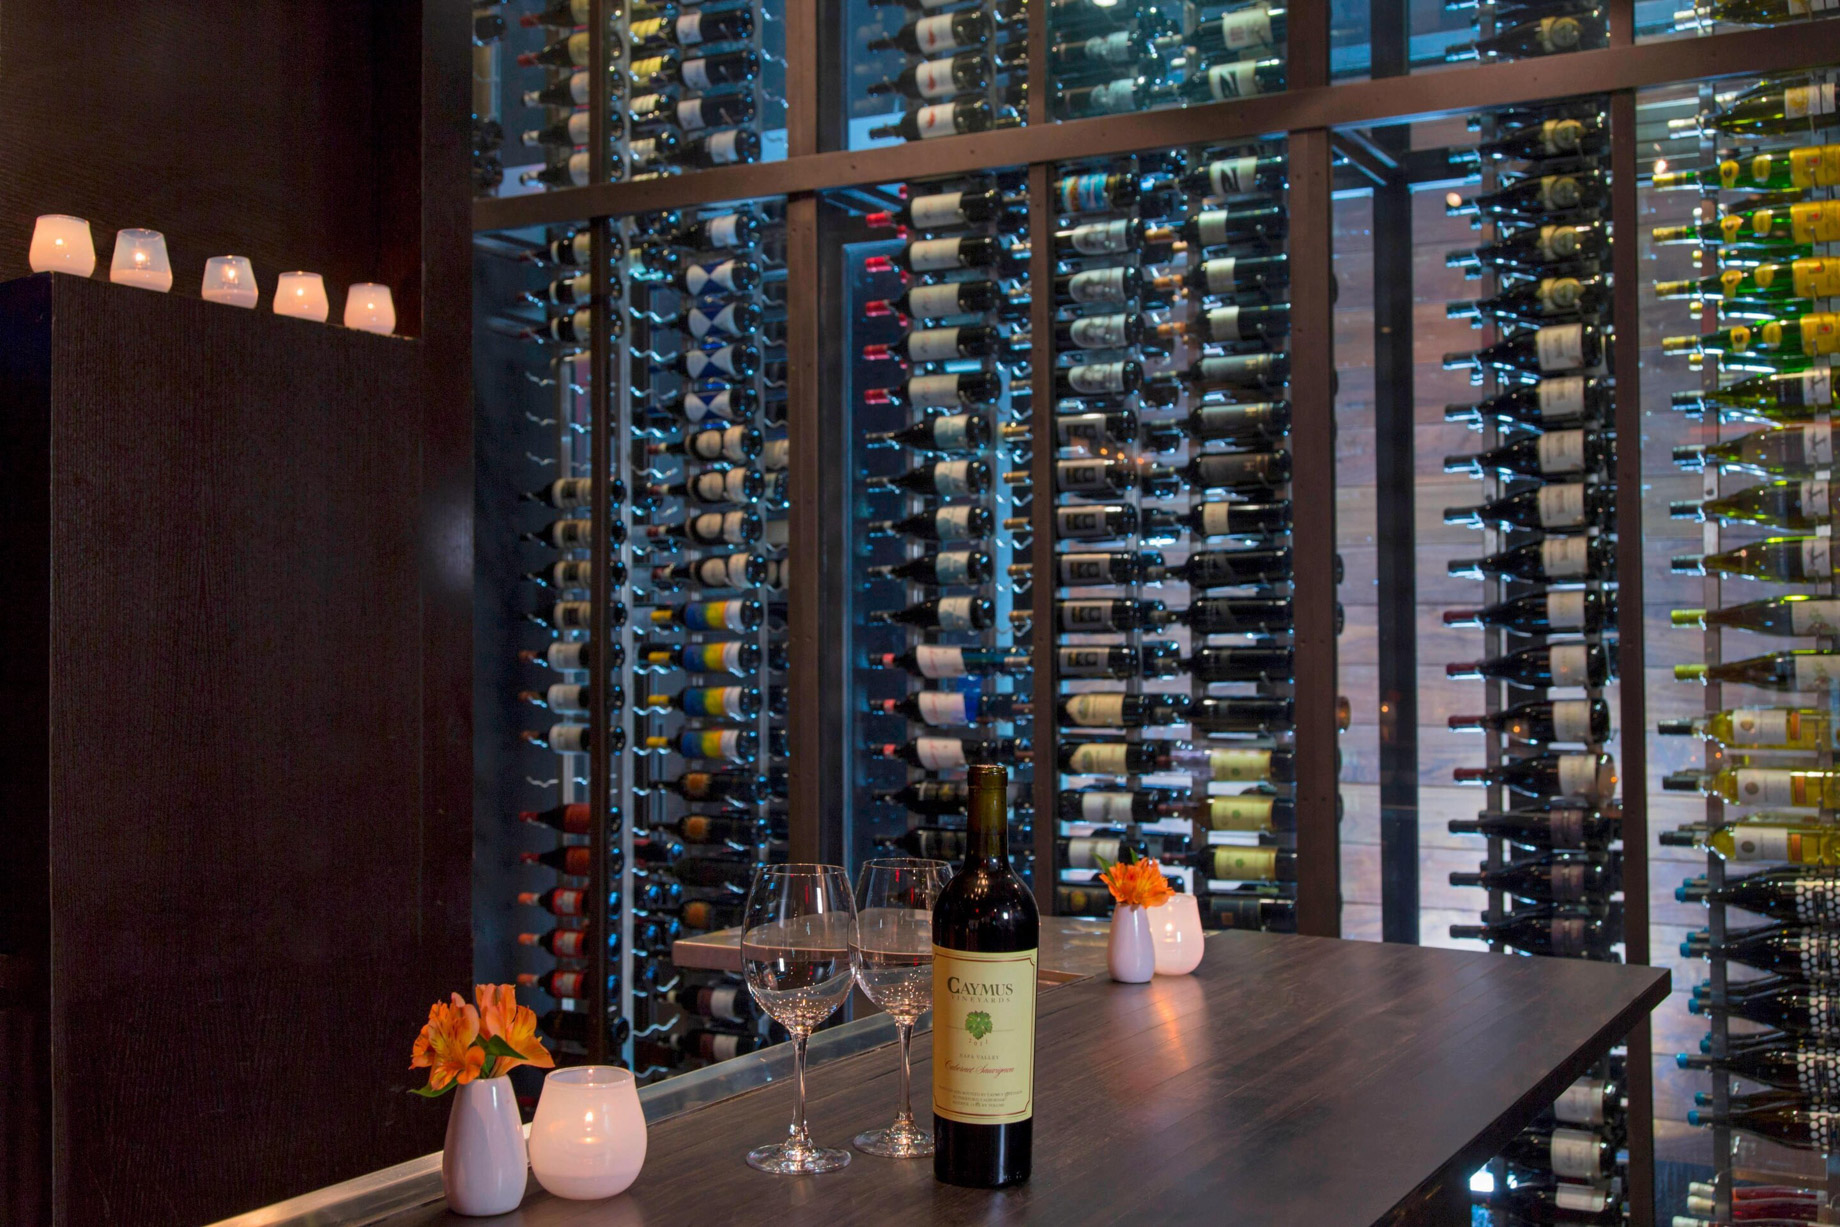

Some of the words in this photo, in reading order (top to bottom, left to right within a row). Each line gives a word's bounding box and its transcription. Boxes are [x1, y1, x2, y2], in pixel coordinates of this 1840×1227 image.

[947, 976, 1014, 996] CAYMUS
[951, 995, 1011, 1003] VINEYARDS
[945, 1059, 975, 1073] Cabernet
[976, 1064, 1014, 1078] Sauvignon
